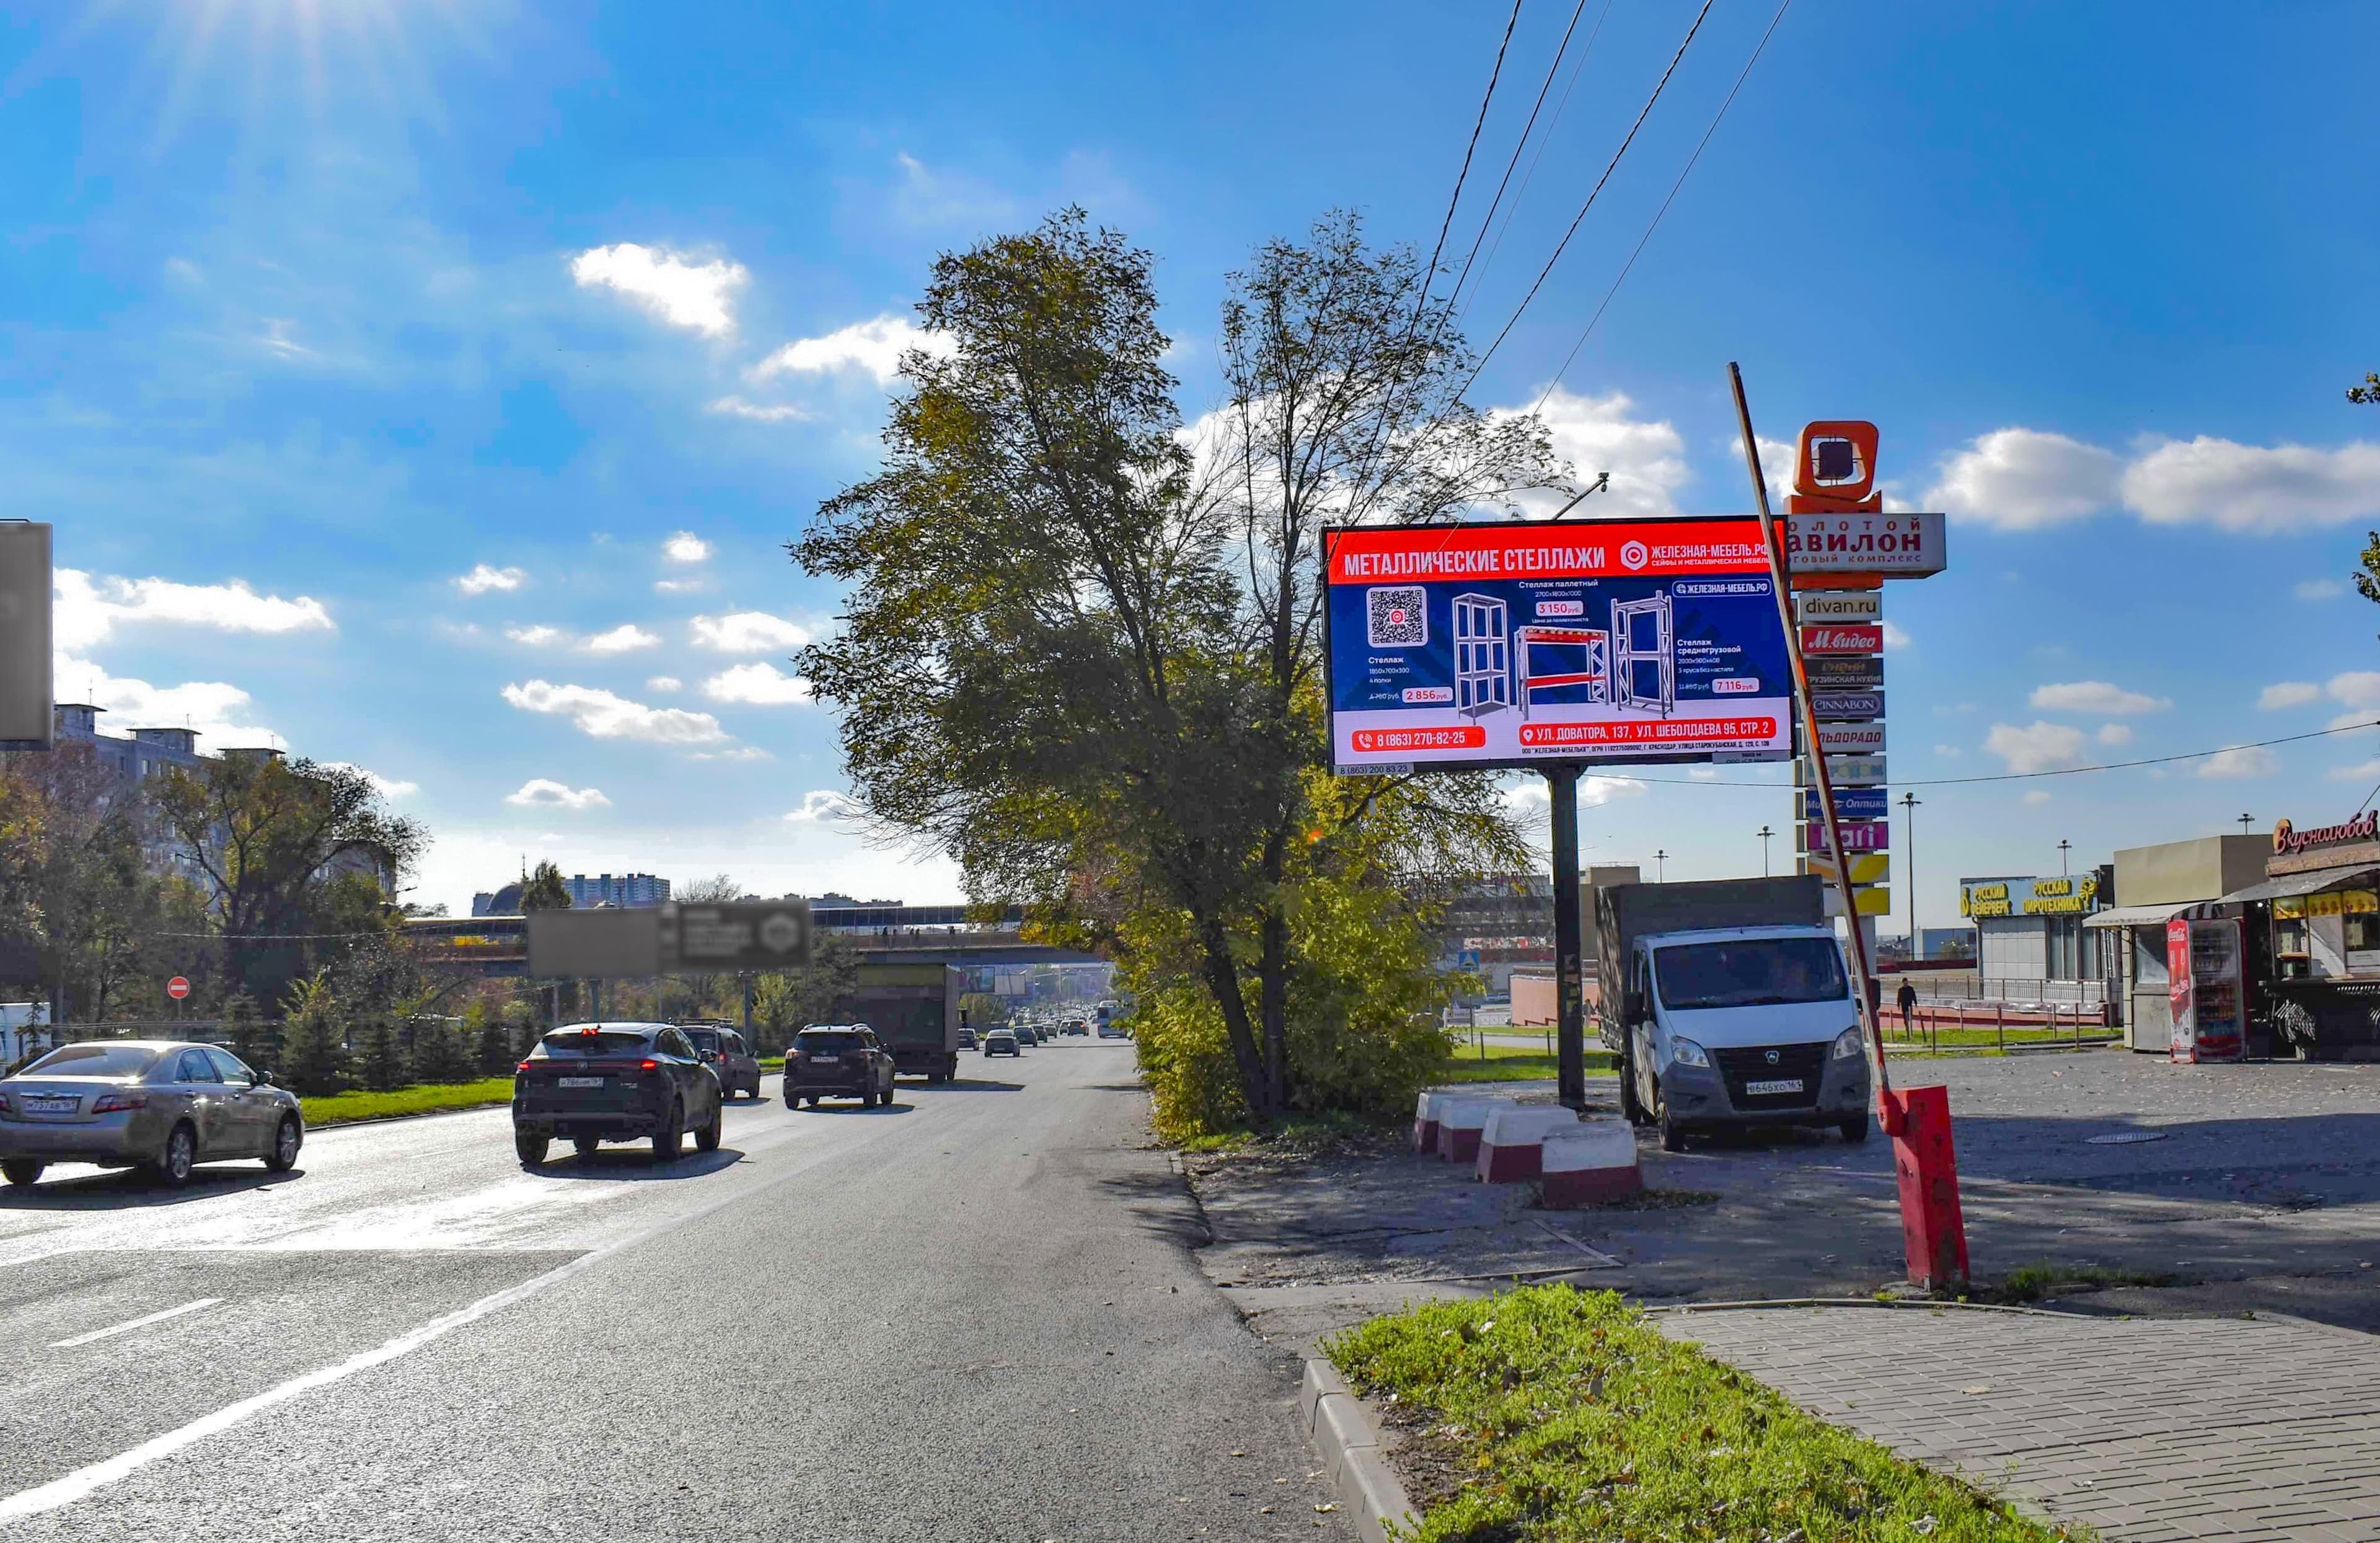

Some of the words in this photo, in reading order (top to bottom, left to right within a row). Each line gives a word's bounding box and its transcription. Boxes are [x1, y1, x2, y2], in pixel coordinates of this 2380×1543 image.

[1789, 517, 1920, 531] олотой
[1789, 534, 1921, 552] авилон
[1651, 544, 1768, 559] ЖЕЛЕЗНАЯ-МЕБЕЛЬ.РФ
[1344, 550, 1500, 575] МЕТАЛЛИЧЕСКИЕ
[1504, 547, 1605, 570] СТЕЛЛАЖИ
[1688, 583, 1767, 594] ЖЕЛЕЗНАЯ-МЕБЕЛЬ.РФ
[1539, 604, 1545, 614] 3
[1806, 598, 1876, 613] divan.ru
[1808, 630, 1876, 648] М.видео
[1678, 645, 1741, 655] среднегрузовой
[1717, 681, 1723, 690] 7
[1725, 681, 1742, 689] 116
[1407, 691, 1413, 700] 2
[1416, 691, 1435, 699] 856
[1813, 699, 1874, 710] CINNABON
[1536, 728, 1554, 741] УЛ.
[1556, 726, 1609, 741] ДОВАТОРА,
[1612, 725, 1633, 739] 137,
[1636, 725, 1654, 738] УЛ.
[1656, 723, 1722, 737] ШЕБОЛДАЕВА
[1724, 722, 1739, 736] 95,
[1740, 722, 1761, 734] СТР.
[1763, 721, 1769, 734] 2
[1819, 732, 1882, 743] ЛЬДОРАДО
[1377, 734, 1384, 747] 8
[1386, 732, 1412, 747] (863)
[1414, 732, 1466, 745] 270-82-25
[1347, 766, 1367, 774] (863)
[1846, 799, 1887, 808] Оптики
[2275, 810, 2378, 855] Вкуснолюбов
[1974, 880, 2008, 901] РУССКИЙ
[2034, 880, 2071, 896] РУССКАЯ
[1971, 900, 2011, 916] ФЕЙЕРВЕРК
[2024, 896, 2082, 913] ПИРОТЕХНИКА
